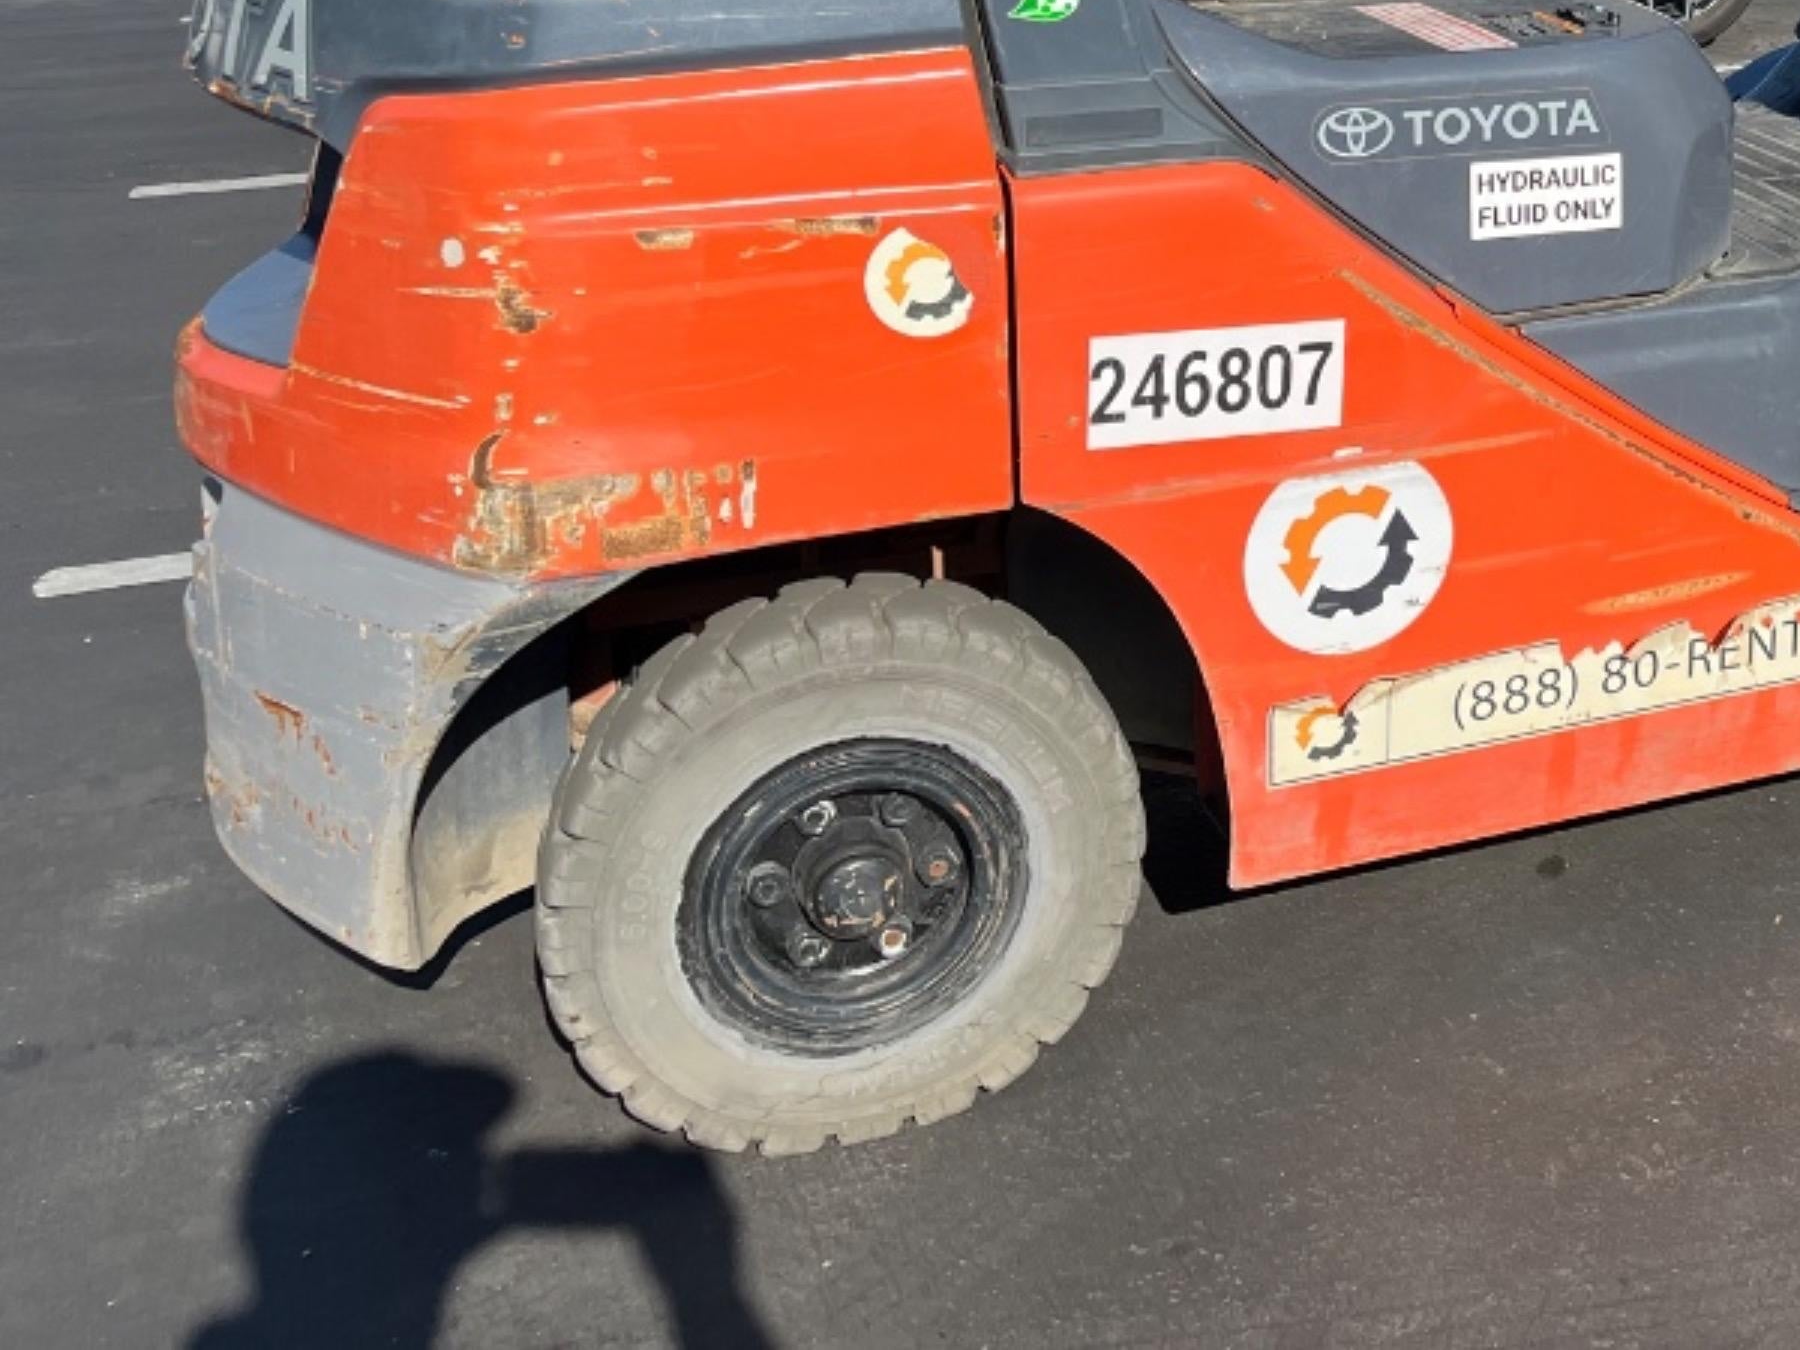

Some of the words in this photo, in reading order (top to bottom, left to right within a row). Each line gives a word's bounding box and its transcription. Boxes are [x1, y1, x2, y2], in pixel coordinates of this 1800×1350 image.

[1403, 98, 1600, 147] TOYOTA
[1477, 164, 1616, 196] HYDRAULIC
[1478, 204, 1548, 229] FLUID
[1554, 197, 1615, 223] ONLY
[1090, 341, 1333, 425] 246807
[1453, 661, 1579, 731] (888)
